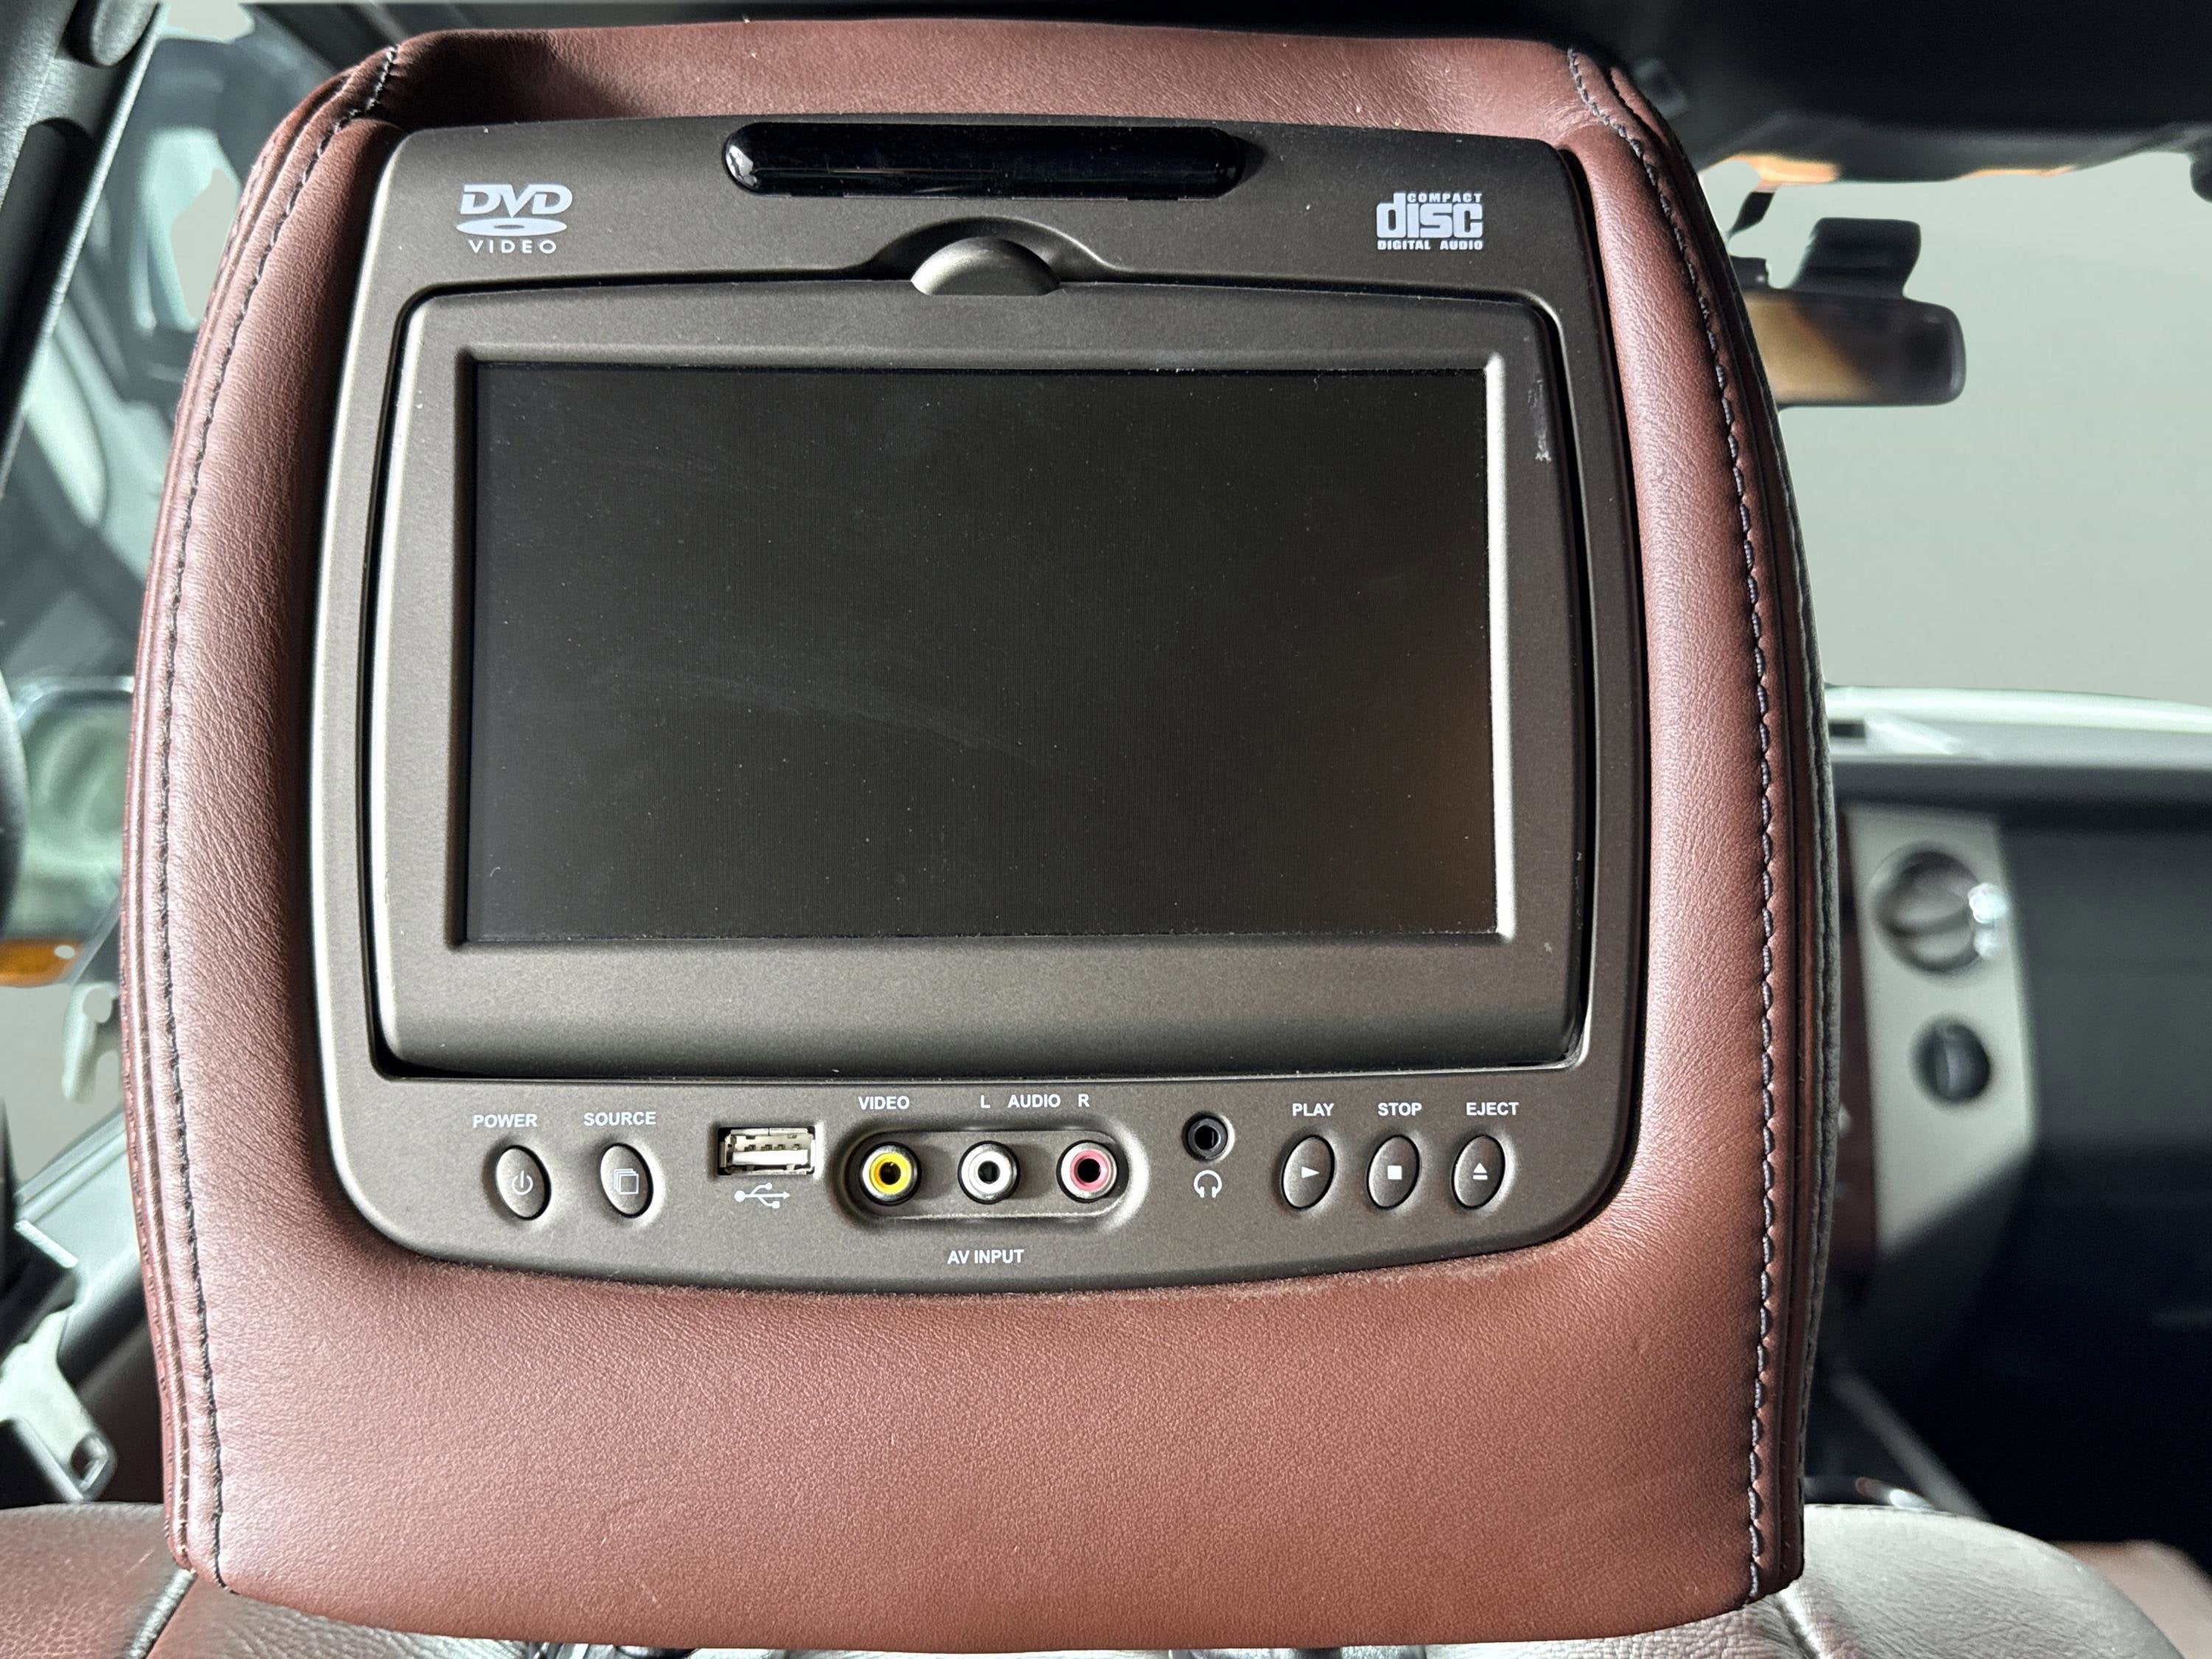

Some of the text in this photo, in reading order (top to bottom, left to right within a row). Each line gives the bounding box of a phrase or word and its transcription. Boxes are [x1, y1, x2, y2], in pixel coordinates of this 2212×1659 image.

[460, 184, 573, 218] DVD
[1407, 192, 1483, 203] COMPACT
[1376, 192, 1484, 239] disc
[468, 239, 557, 254] VIDEO
[1377, 240, 1484, 251] DIGITAL AUDIO
[858, 1095, 911, 1110] VIDEO
[980, 1093, 1091, 1109] L AUDIO R
[1292, 1102, 1335, 1117] PLAY
[1377, 1102, 1422, 1116] STOP
[1466, 1102, 1520, 1116] EJECT
[472, 1113, 538, 1128] POWER
[583, 1110, 657, 1127] SOURCE
[947, 1248, 1025, 1265] AV INPUT
